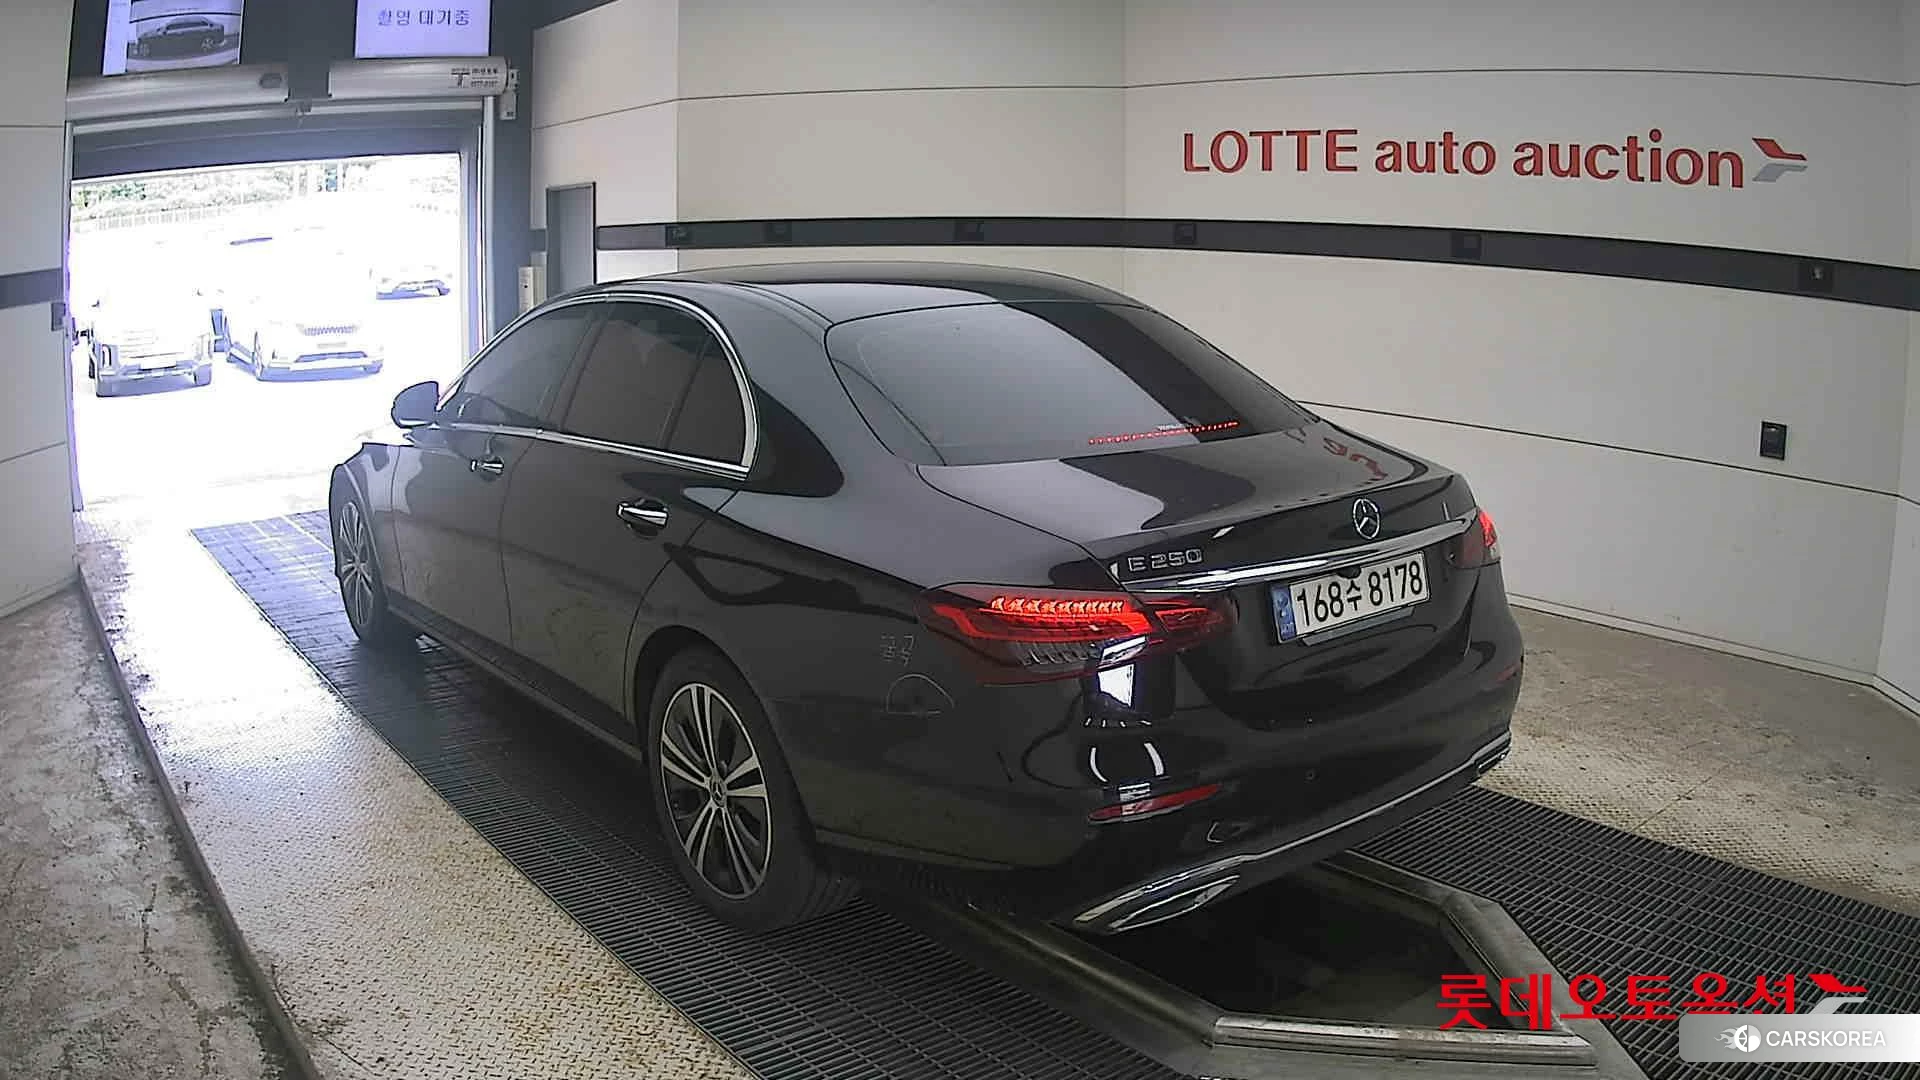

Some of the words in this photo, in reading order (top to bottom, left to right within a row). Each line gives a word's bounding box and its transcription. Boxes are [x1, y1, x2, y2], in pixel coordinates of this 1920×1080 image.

[419, 9, 470, 26] 대기중
[1183, 129, 1359, 173] LOTTE
[1374, 131, 1496, 176] auto
[1513, 129, 1745, 188] auction
[1127, 556, 1147, 571] E
[1150, 548, 1202, 569] 250
